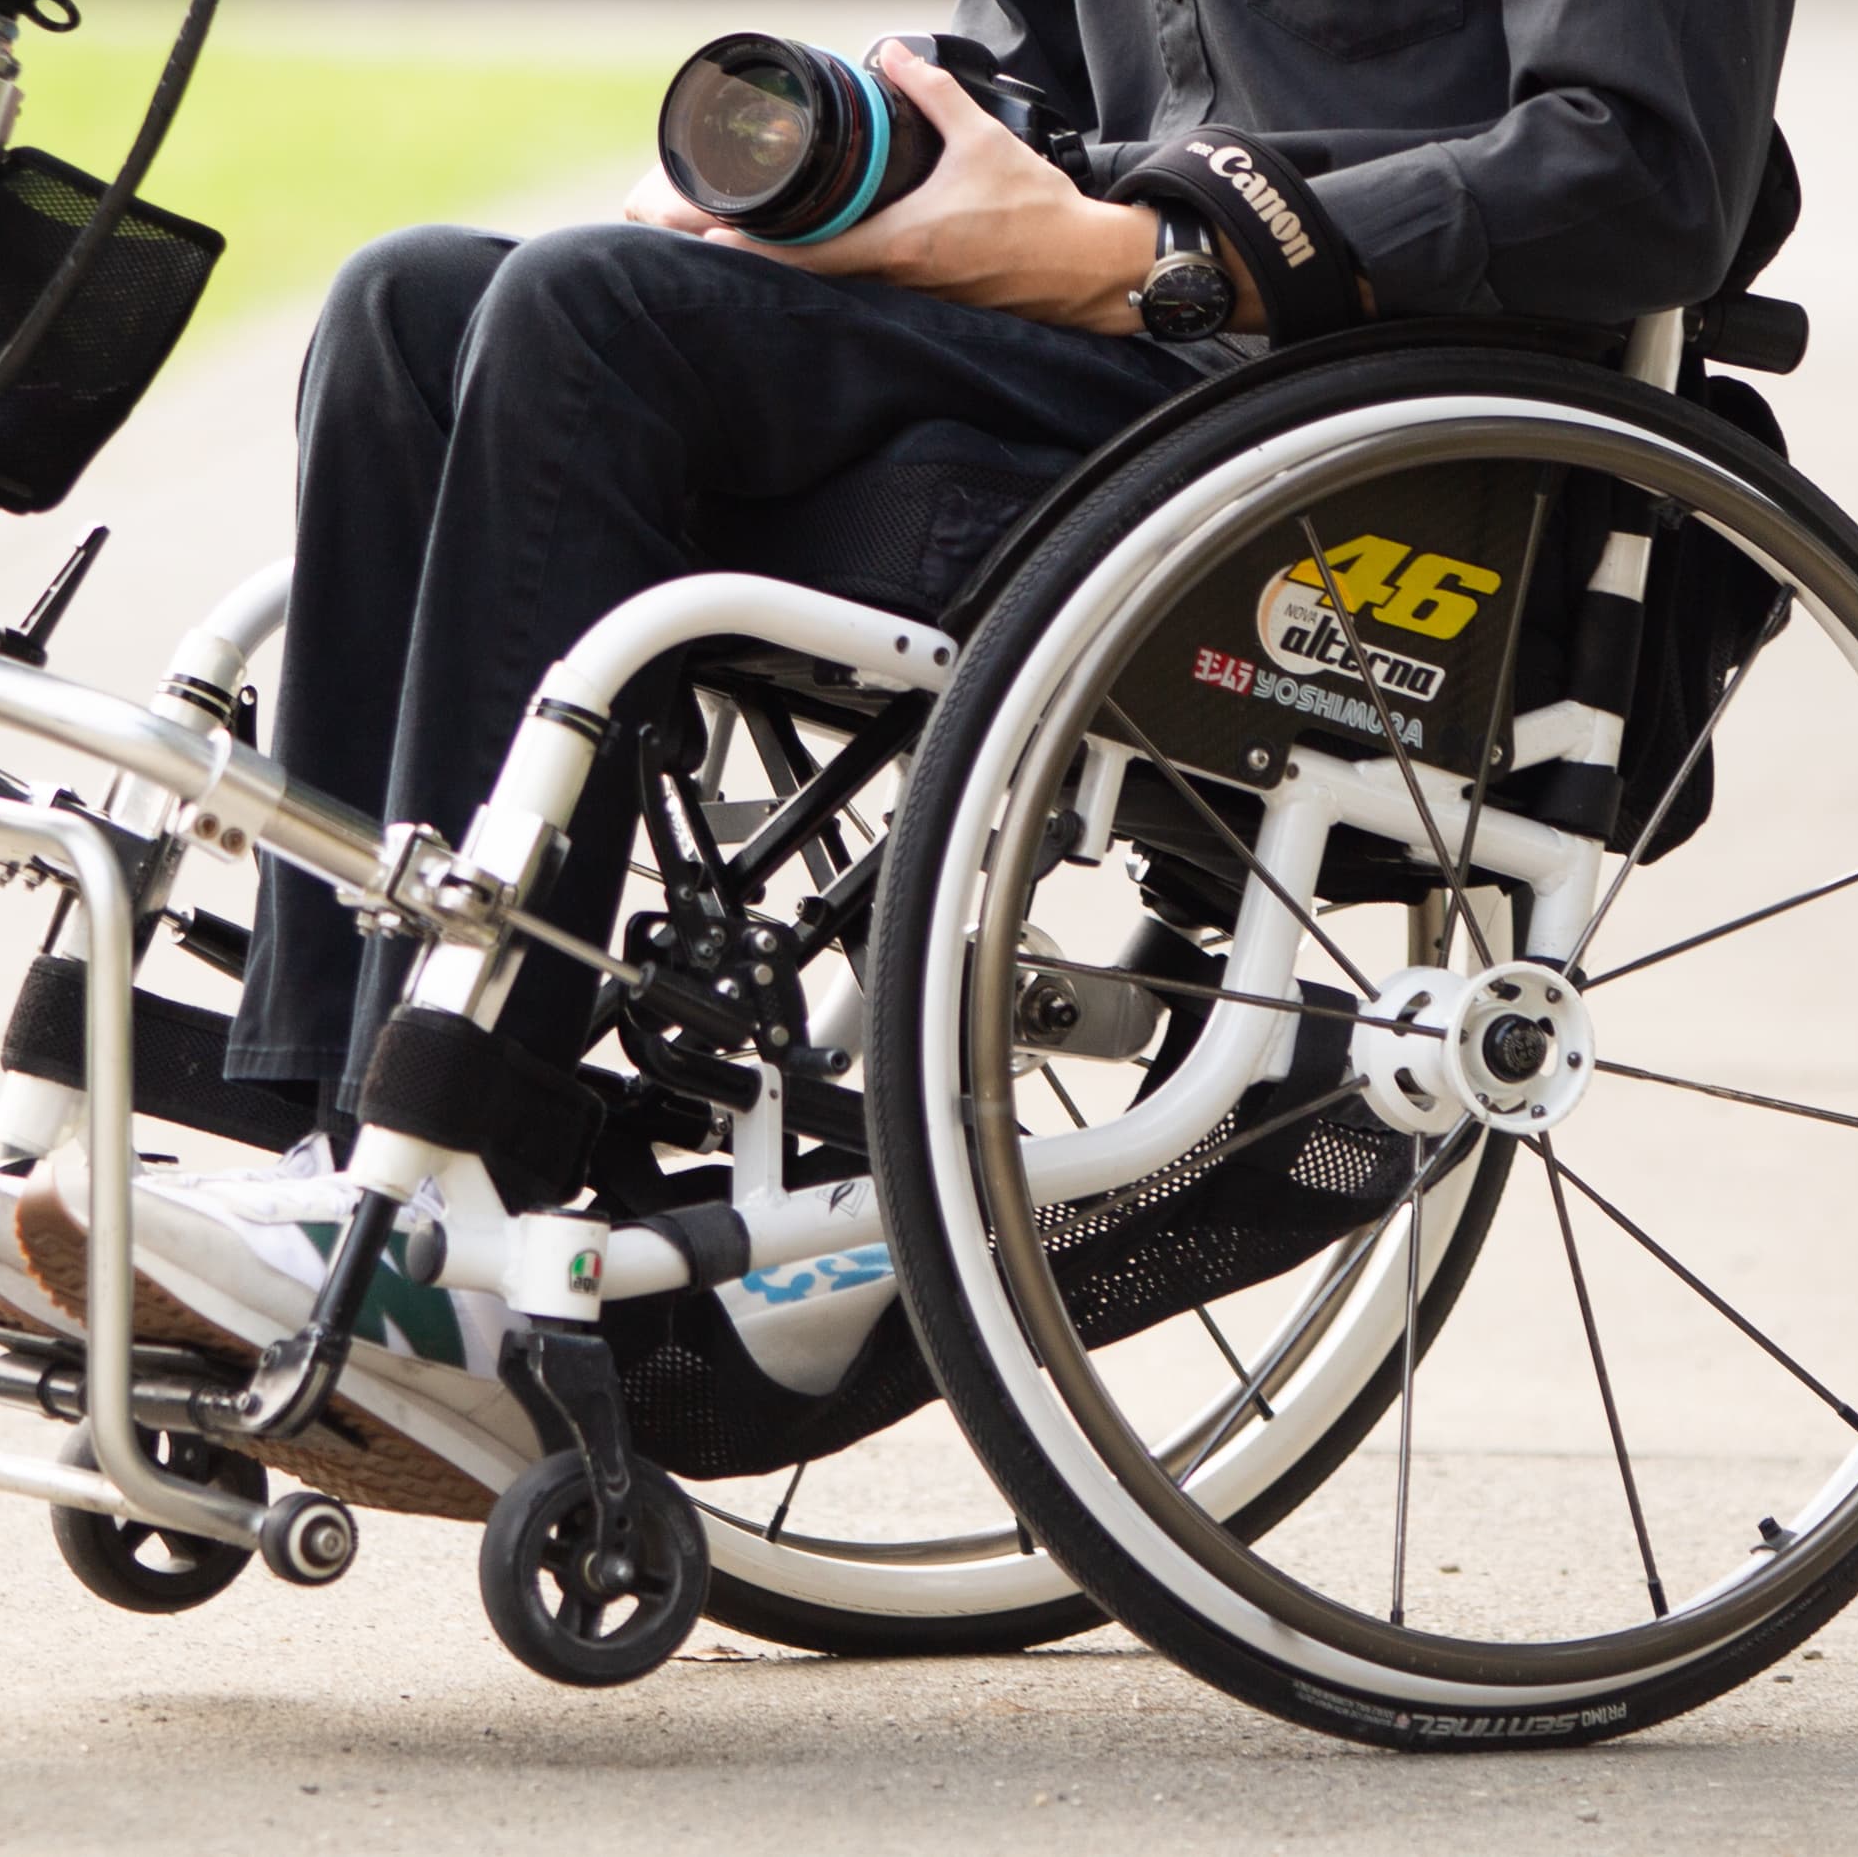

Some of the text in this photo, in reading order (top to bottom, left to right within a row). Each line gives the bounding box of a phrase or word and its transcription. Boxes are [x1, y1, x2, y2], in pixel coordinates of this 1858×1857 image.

[1209, 146, 1316, 269] Canon
[1284, 533, 1502, 641] 46
[1284, 602, 1318, 626] NOVA
[1194, 648, 1255, 694] ヨシムラ
[1279, 614, 1438, 694] alterna
[1253, 668, 1424, 750] YOSHIMURA
[1411, 1701, 1627, 1738] PRIMO SENTINEL
